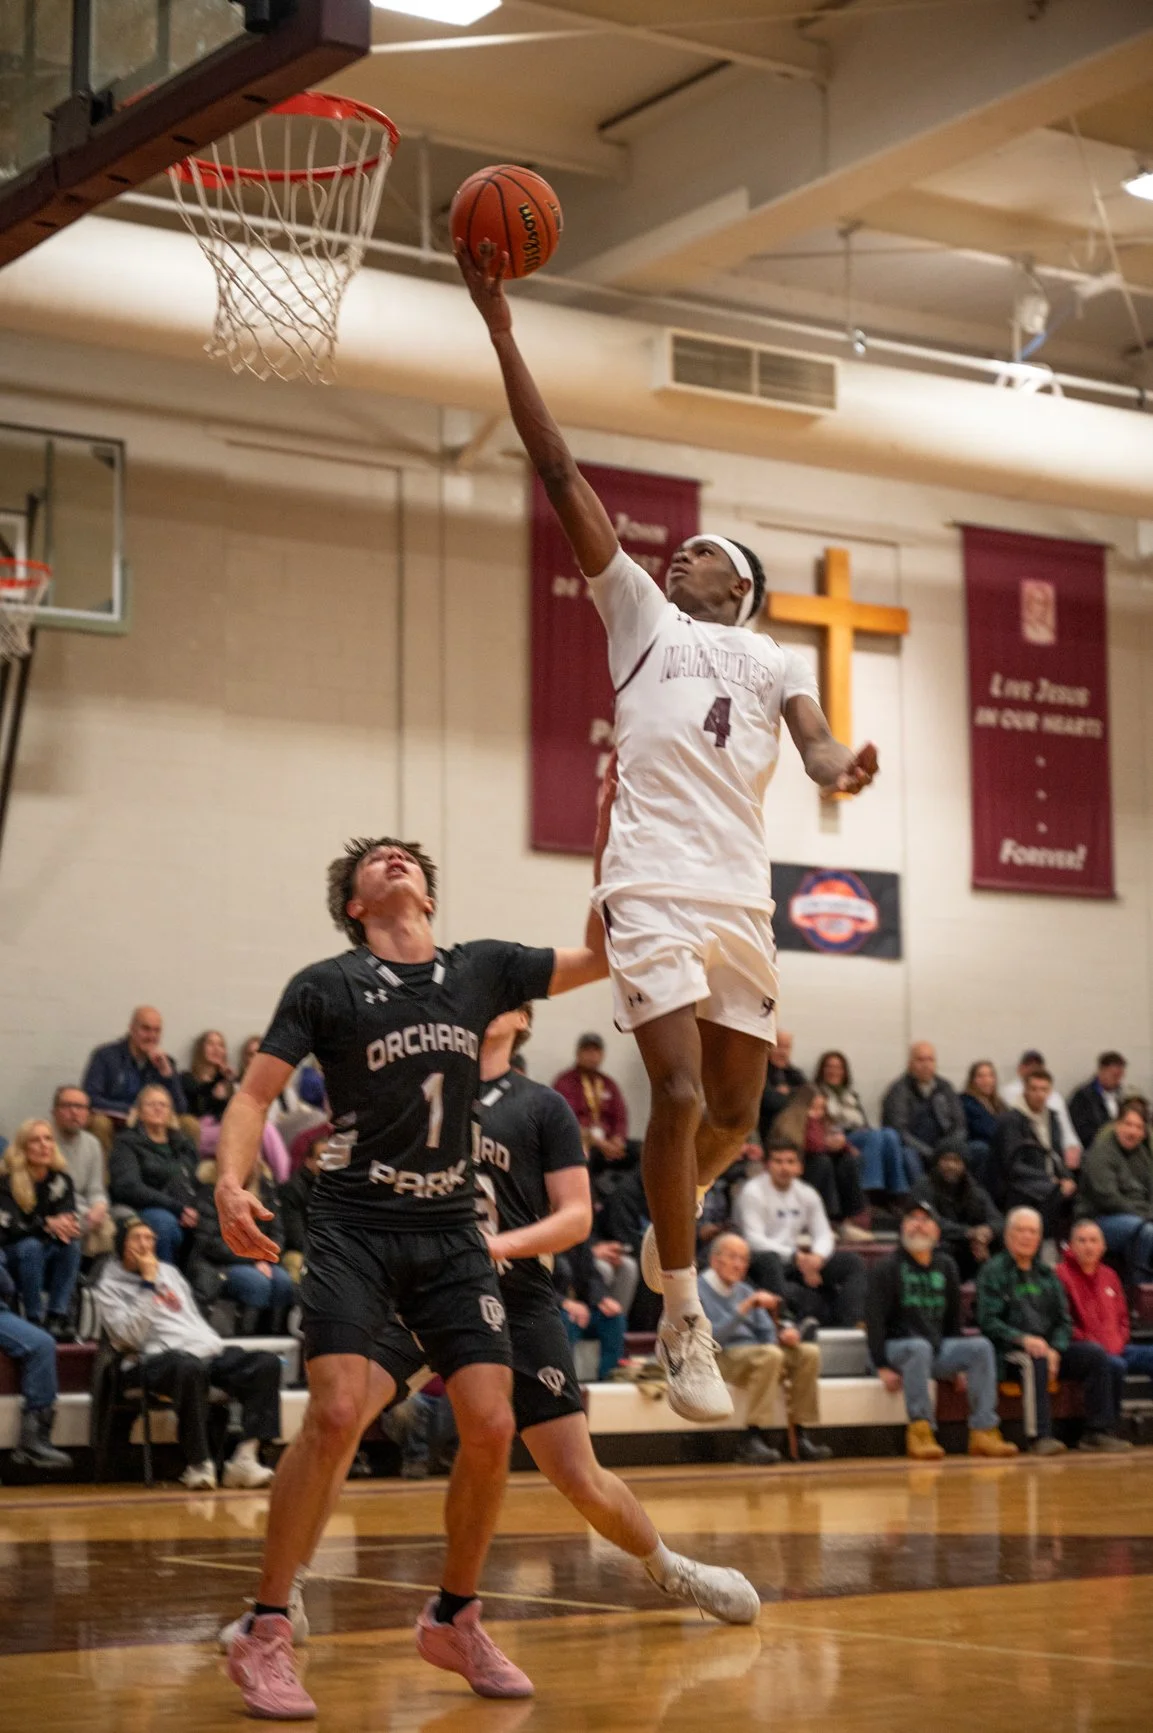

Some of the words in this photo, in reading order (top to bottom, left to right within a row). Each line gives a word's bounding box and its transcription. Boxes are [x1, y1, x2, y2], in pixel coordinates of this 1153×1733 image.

[518, 202, 541, 272] Wilson
[703, 696, 731, 748] 4
[366, 1022, 479, 1072] ORCHARD
[421, 1072, 444, 1149] 1
[368, 1159, 467, 1199] PARK
